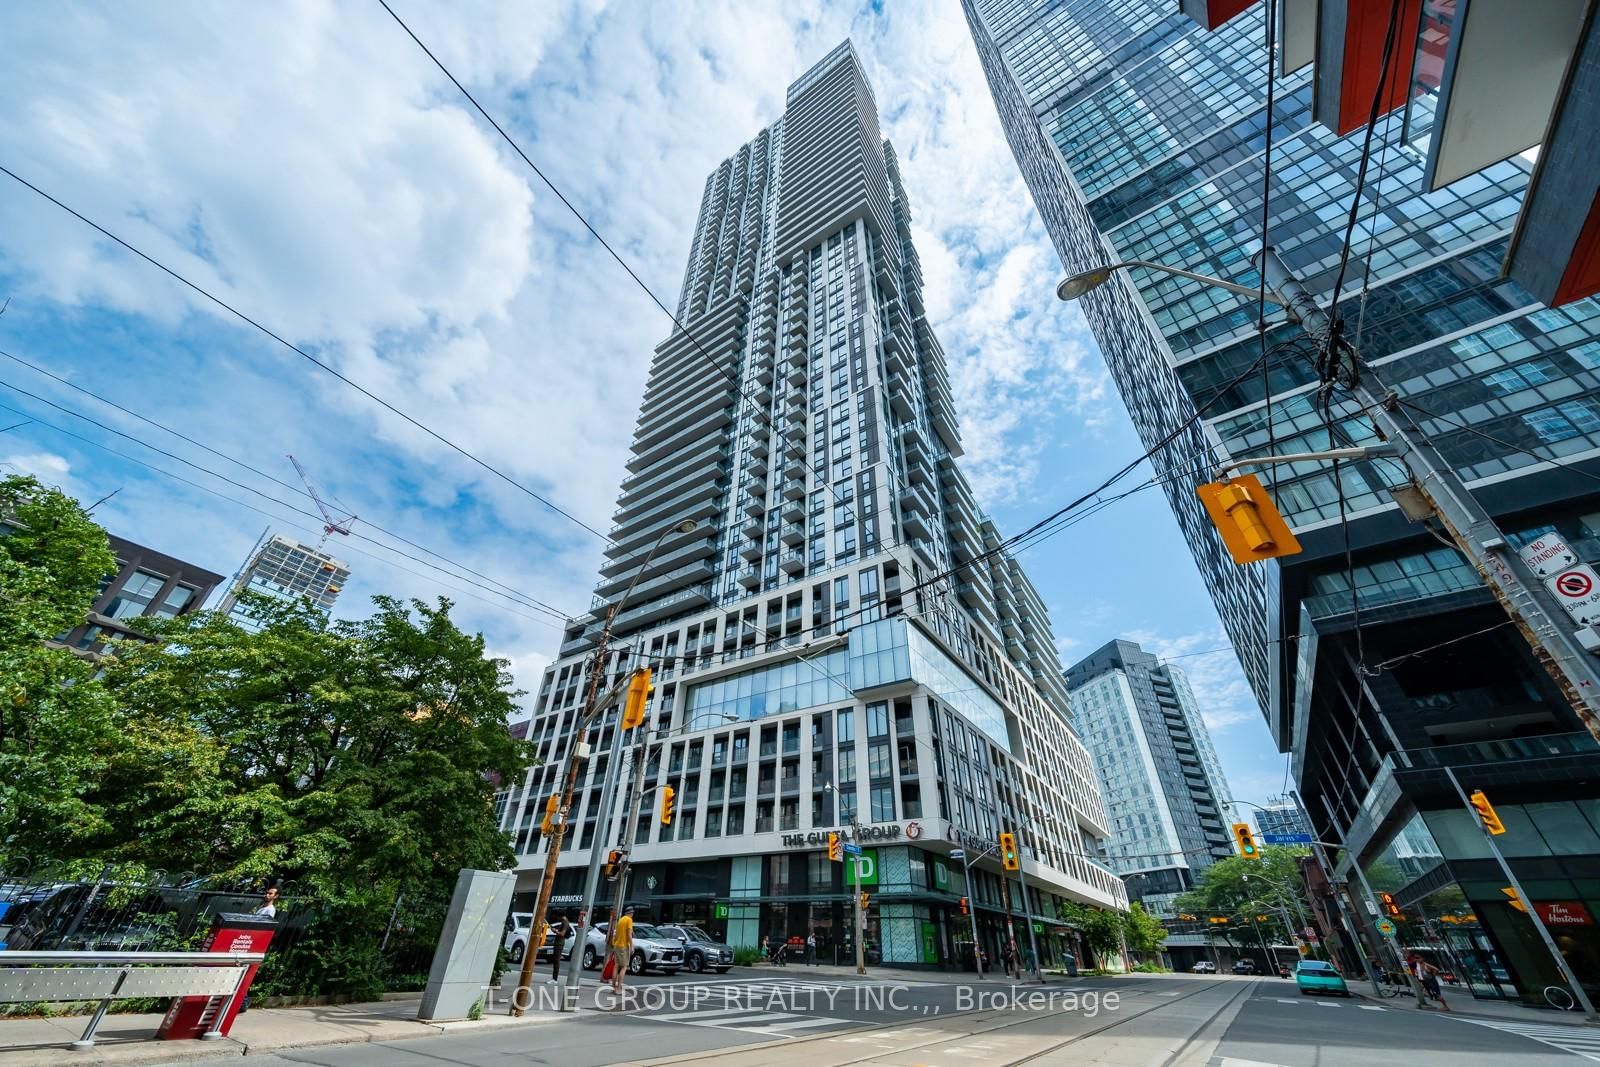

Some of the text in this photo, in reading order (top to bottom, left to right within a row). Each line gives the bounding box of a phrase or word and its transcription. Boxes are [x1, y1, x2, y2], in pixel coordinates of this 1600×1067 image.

[1530, 541, 1546, 553] NO
[1527, 542, 1566, 568] STANDING
[781, 833, 805, 847] THE
[551, 894, 583, 903] STARBUCKS
[1549, 904, 1568, 914] Tim
[1548, 913, 1585, 923] Hortons
